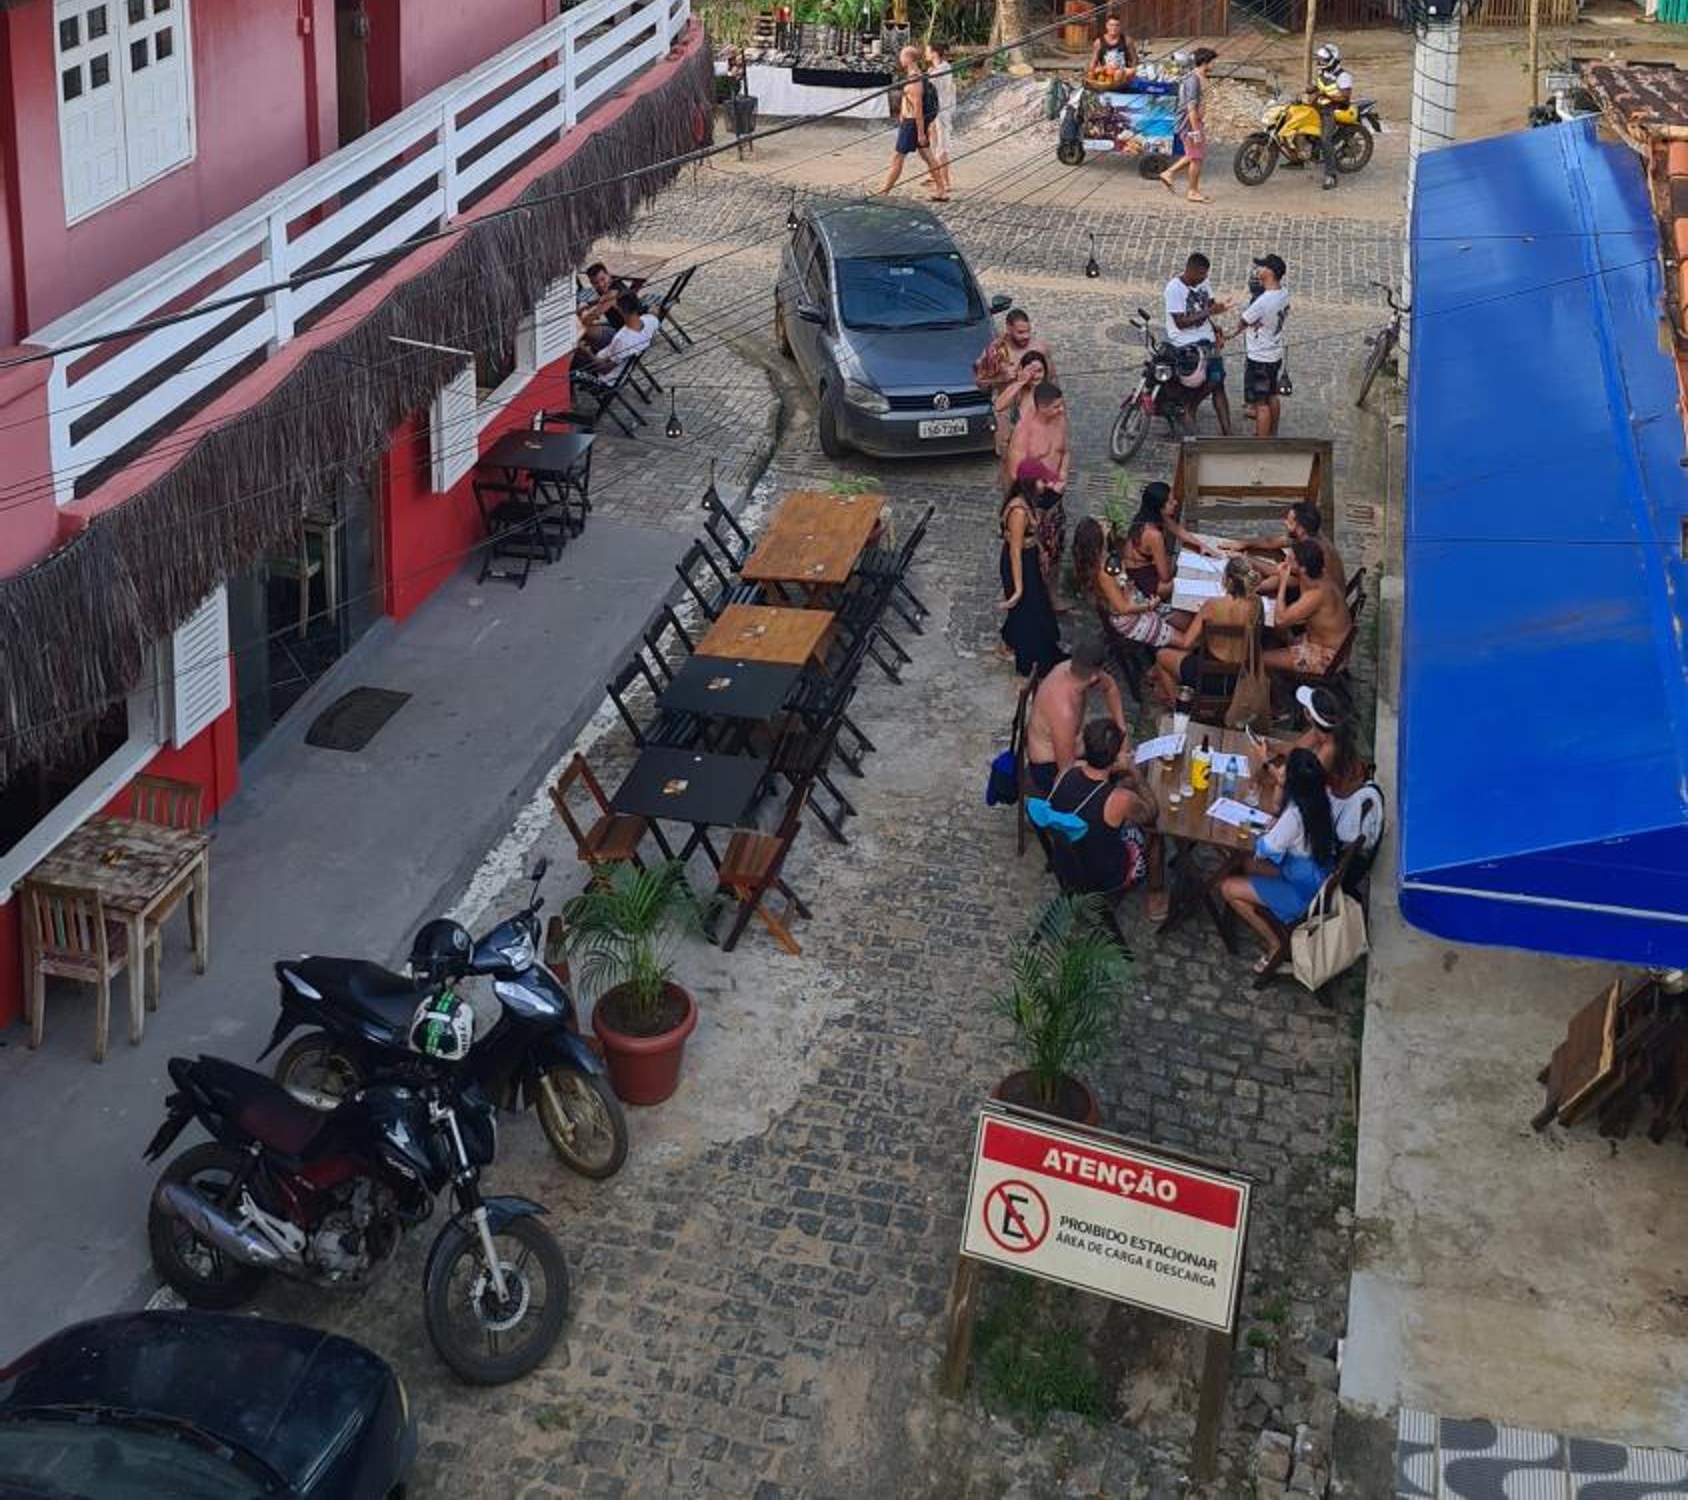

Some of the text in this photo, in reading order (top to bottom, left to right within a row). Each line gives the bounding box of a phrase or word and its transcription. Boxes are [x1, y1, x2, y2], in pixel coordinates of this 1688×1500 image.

[1042, 1148, 1178, 1201] ATENÇÃO
[1060, 1215, 1217, 1272] PROIBIDO ESTACIONAR
[1088, 1241, 1103, 1255] DE
[1105, 1247, 1144, 1267] CARGA
[1155, 1261, 1216, 1288] DESCARGA
